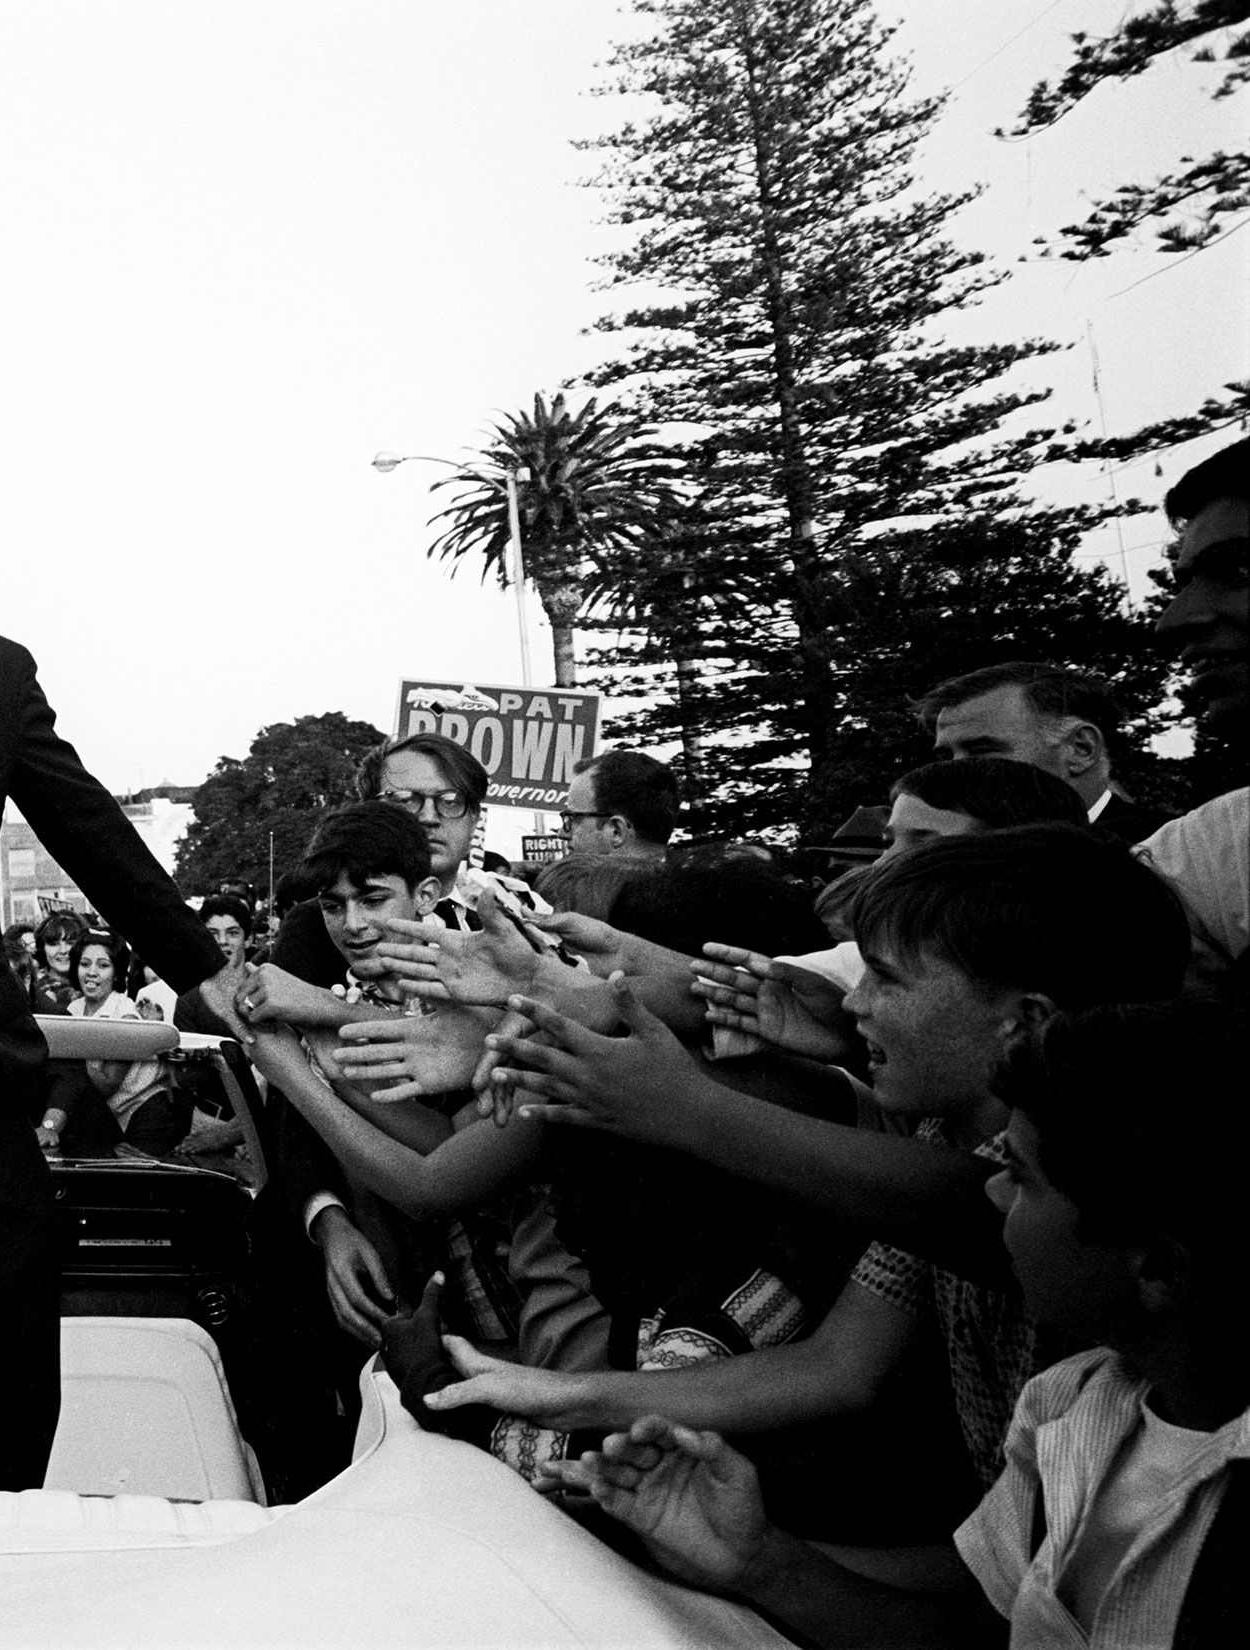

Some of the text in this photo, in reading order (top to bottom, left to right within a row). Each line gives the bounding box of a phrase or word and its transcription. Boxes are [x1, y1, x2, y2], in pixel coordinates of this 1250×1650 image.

[499, 692, 584, 721] PAT
[486, 781, 570, 806] overnor
[525, 838, 563, 850] RIGHT
